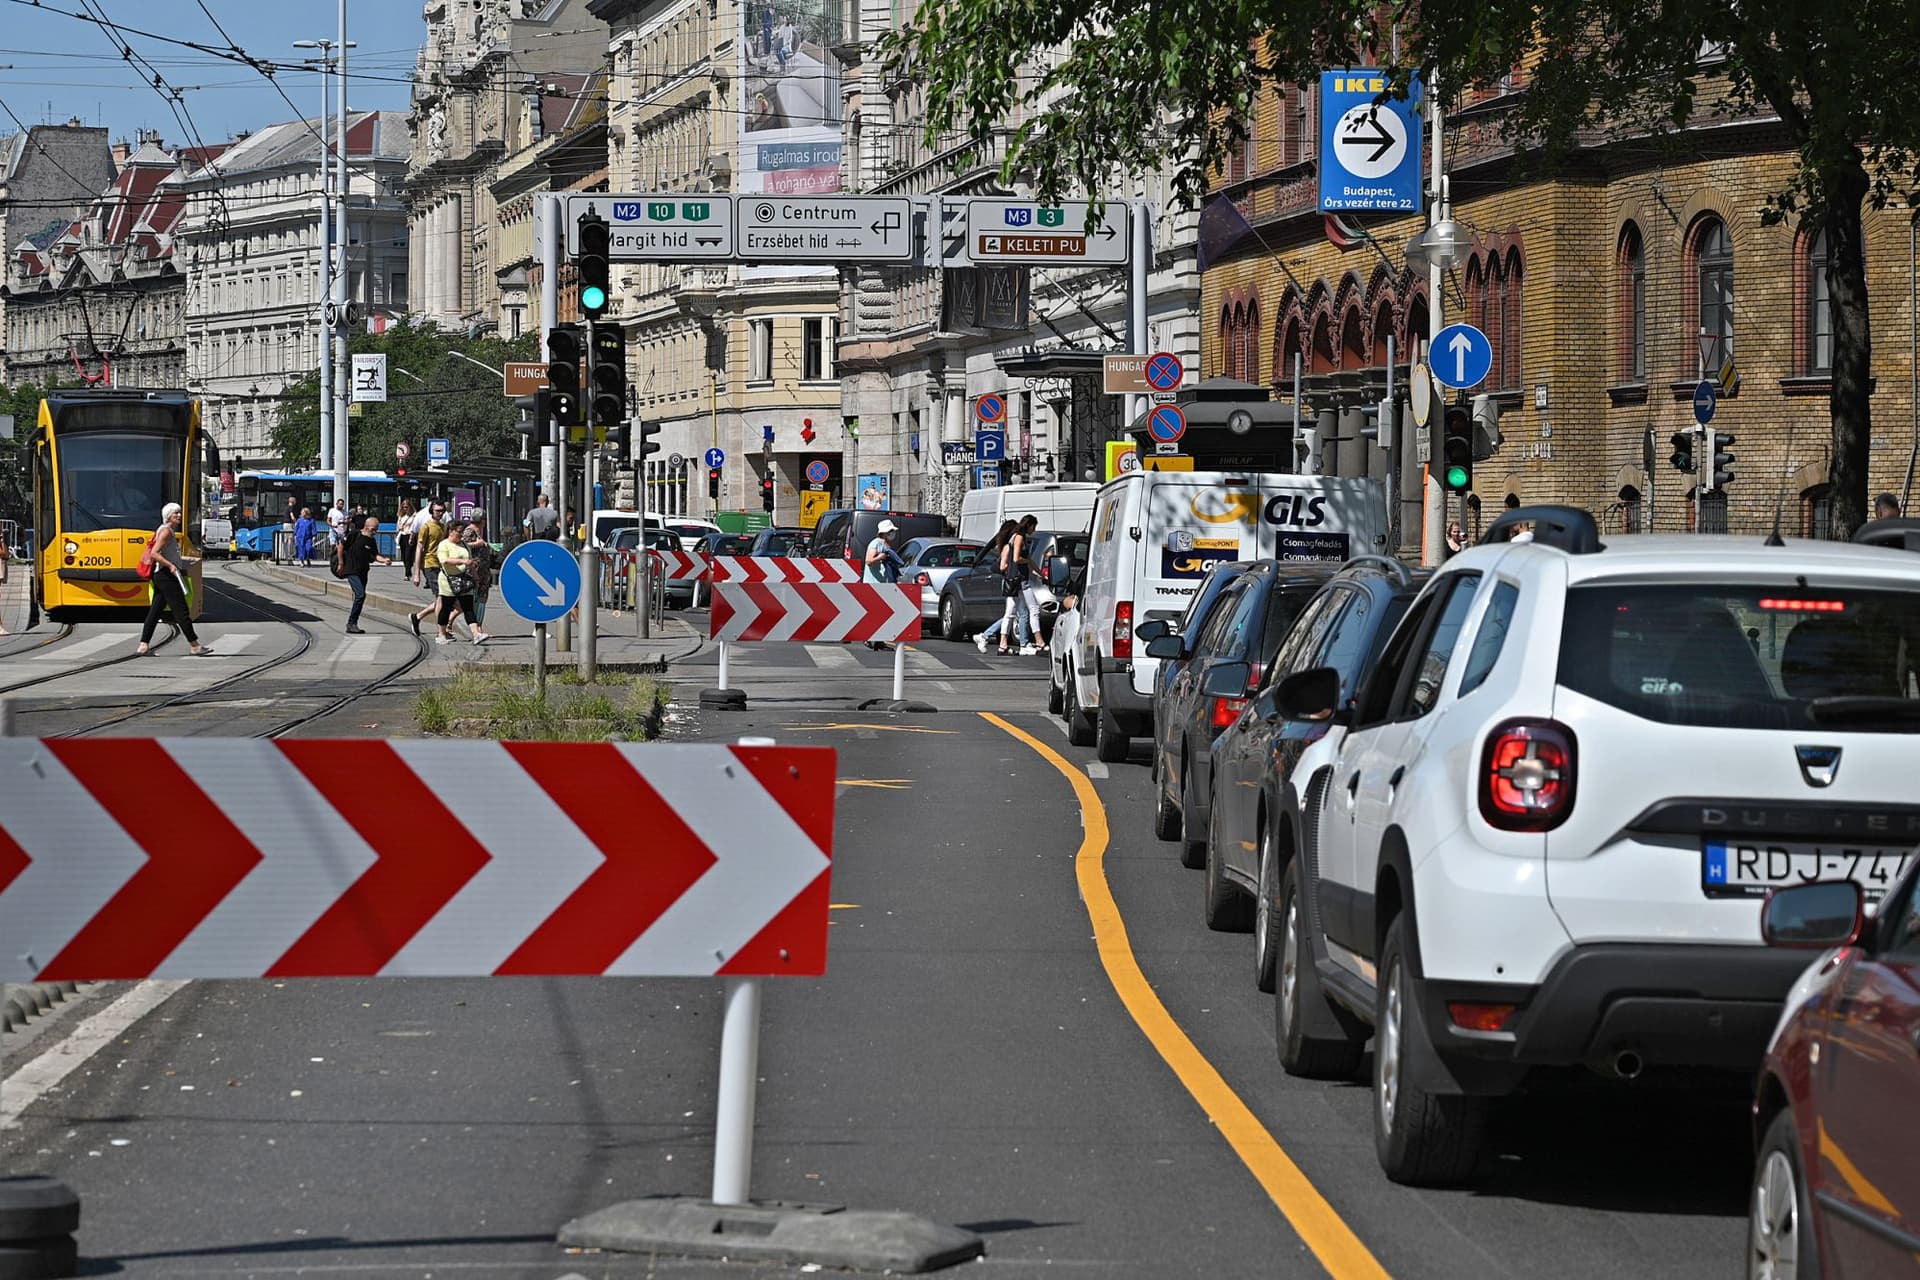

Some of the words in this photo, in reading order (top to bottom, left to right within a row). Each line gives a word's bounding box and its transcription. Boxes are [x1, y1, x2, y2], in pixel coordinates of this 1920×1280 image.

[1334, 78, 1397, 92] IKE
[761, 147, 810, 167] Rugalmas
[813, 147, 840, 162] irod
[775, 173, 816, 192] rohanó
[819, 171, 840, 187] vár
[1343, 186, 1396, 198] Budapest,
[1345, 197, 1373, 208] vezér
[1376, 199, 1398, 208] tere
[1400, 199, 1415, 208] 22.
[617, 205, 637, 217] M2
[655, 205, 669, 217] 10
[690, 205, 702, 217] 11
[782, 204, 857, 220] Centrum
[1008, 210, 1028, 223] M3
[1046, 211, 1055, 224] 3
[748, 232, 804, 248] Erzsébet
[1007, 239, 1053, 252] KELETI
[1060, 240, 1082, 252] PU.
[513, 367, 548, 379] HUNGA
[1108, 361, 1146, 372] HUNGAR
[983, 441, 996, 457] P
[1264, 494, 1327, 527] GLS
[84, 555, 112, 567] 2009
[1710, 865, 1722, 878] H
